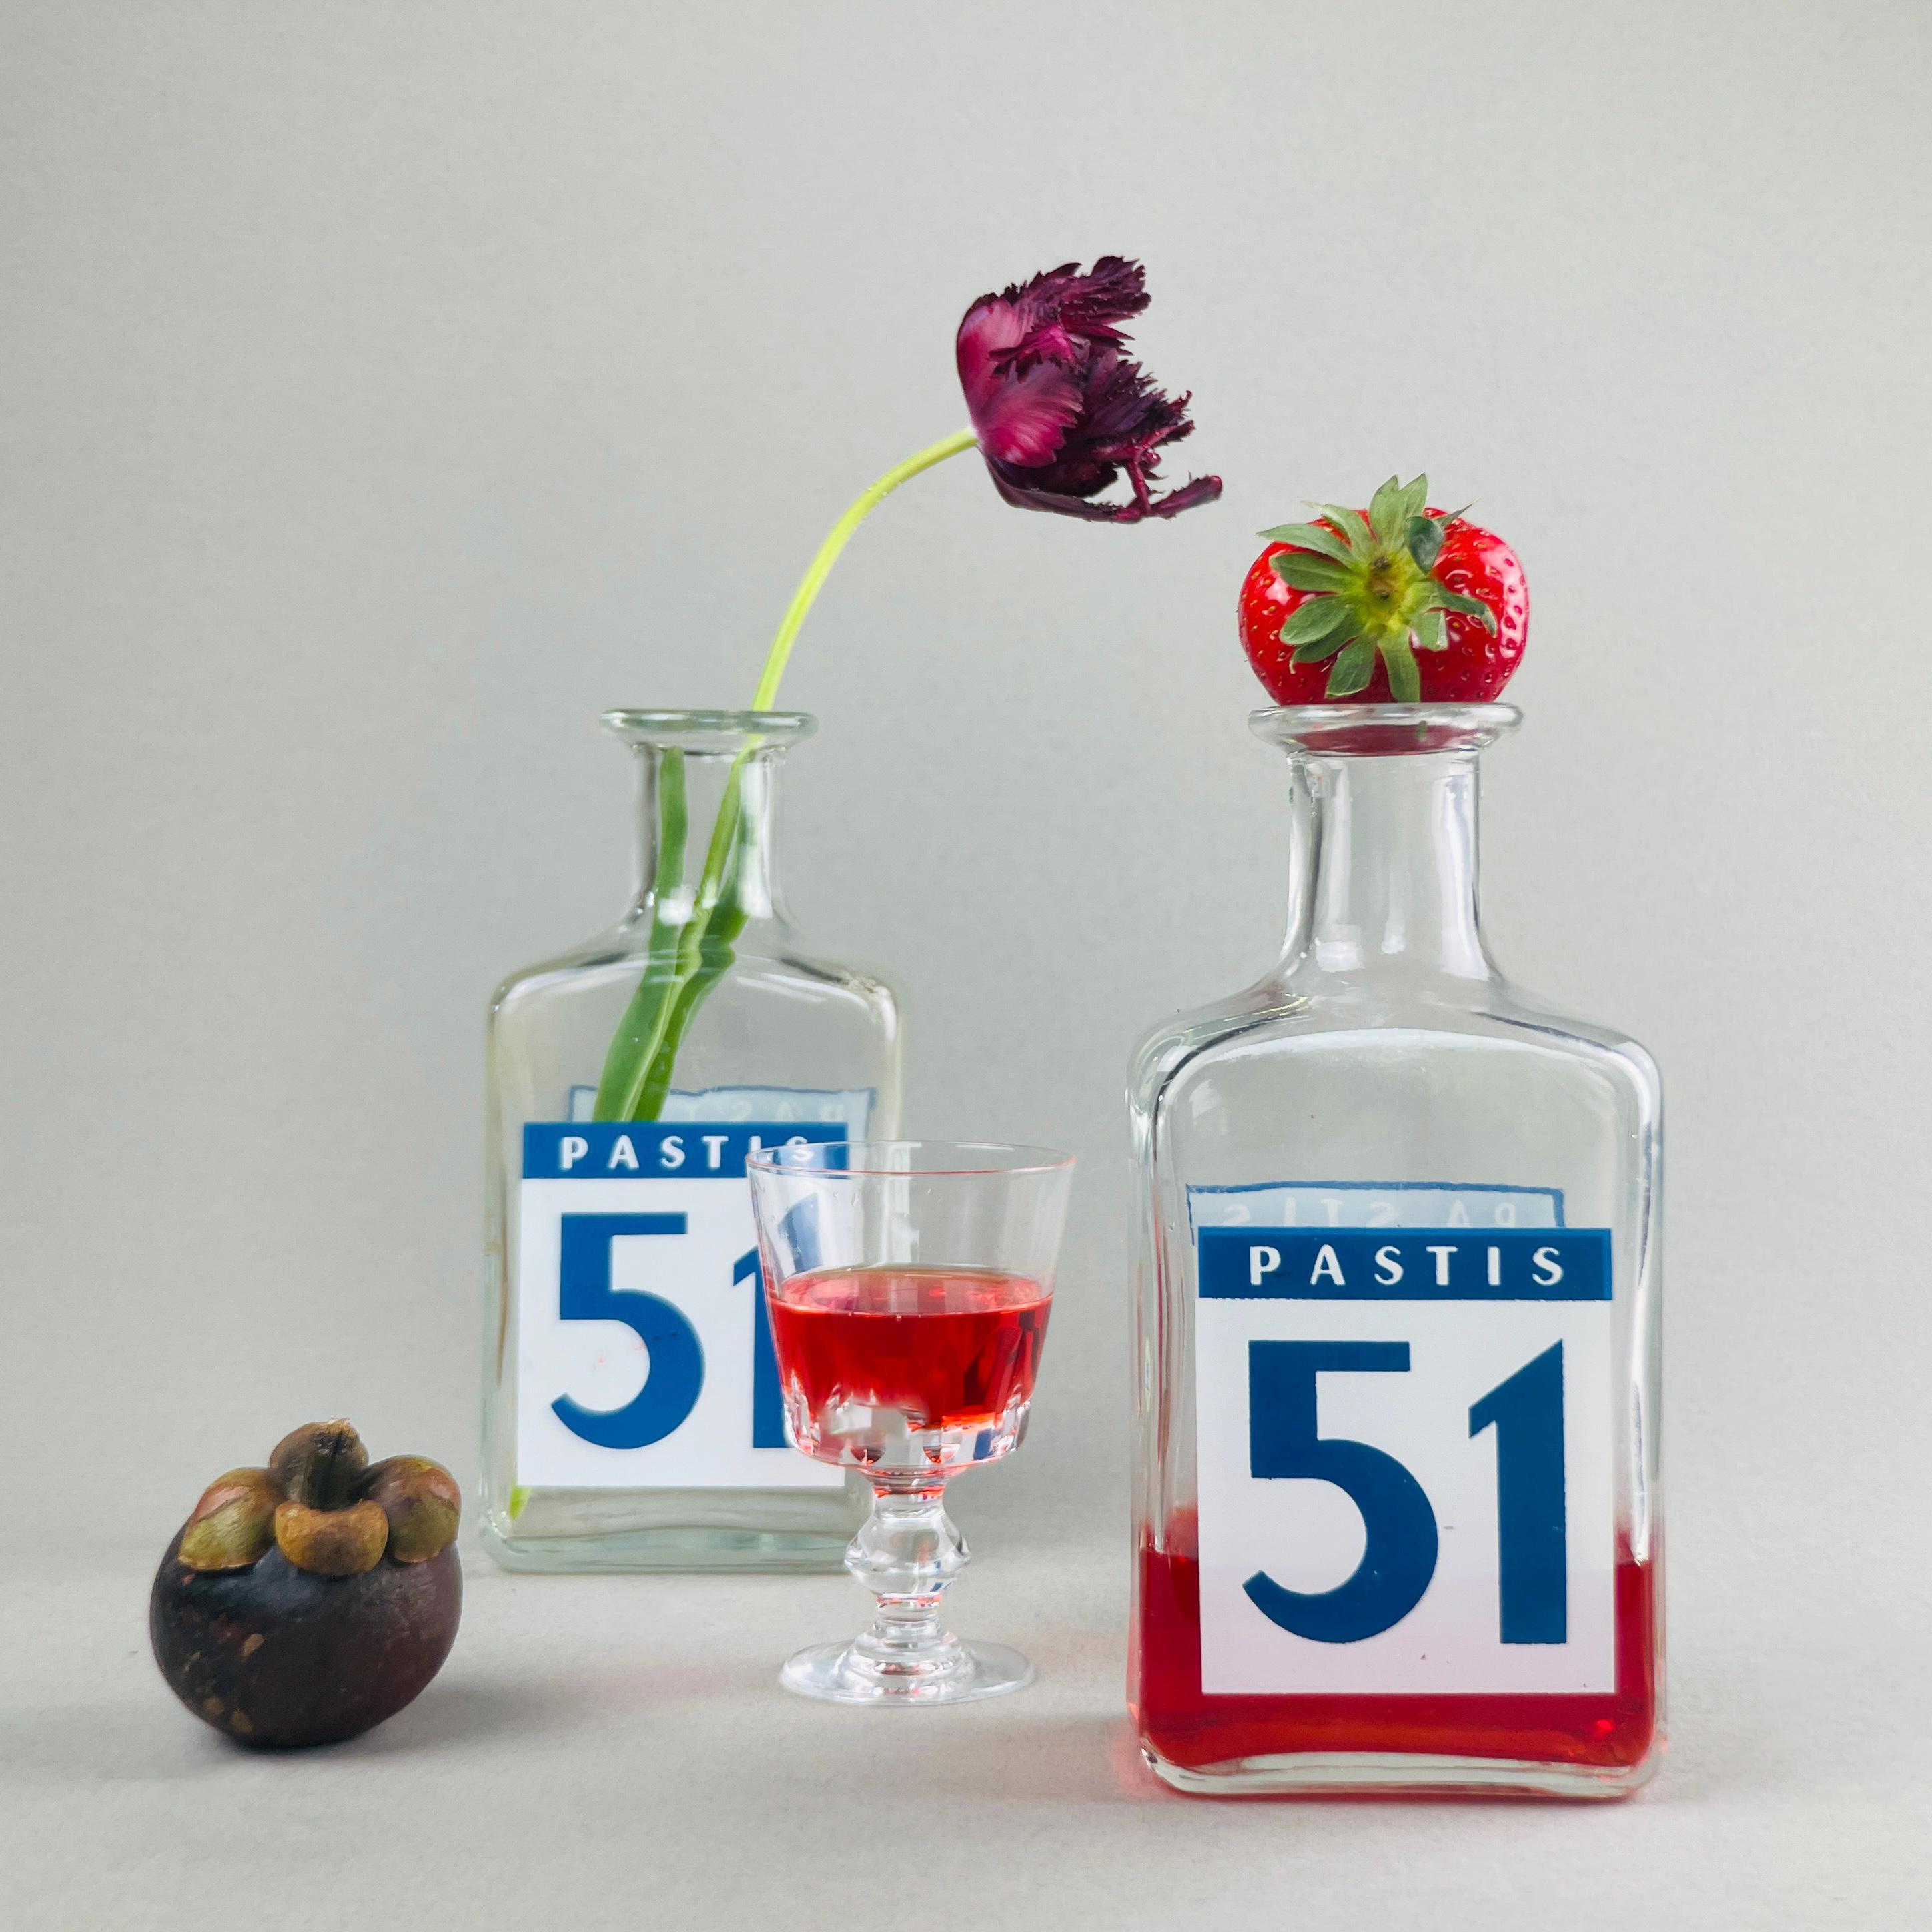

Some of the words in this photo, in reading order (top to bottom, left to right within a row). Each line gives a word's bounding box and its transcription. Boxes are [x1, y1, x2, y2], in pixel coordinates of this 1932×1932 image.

[551, 1212, 806, 1449] 51
[1250, 1244, 1564, 1286] PASTIS
[1242, 1338, 1567, 1644] 51
